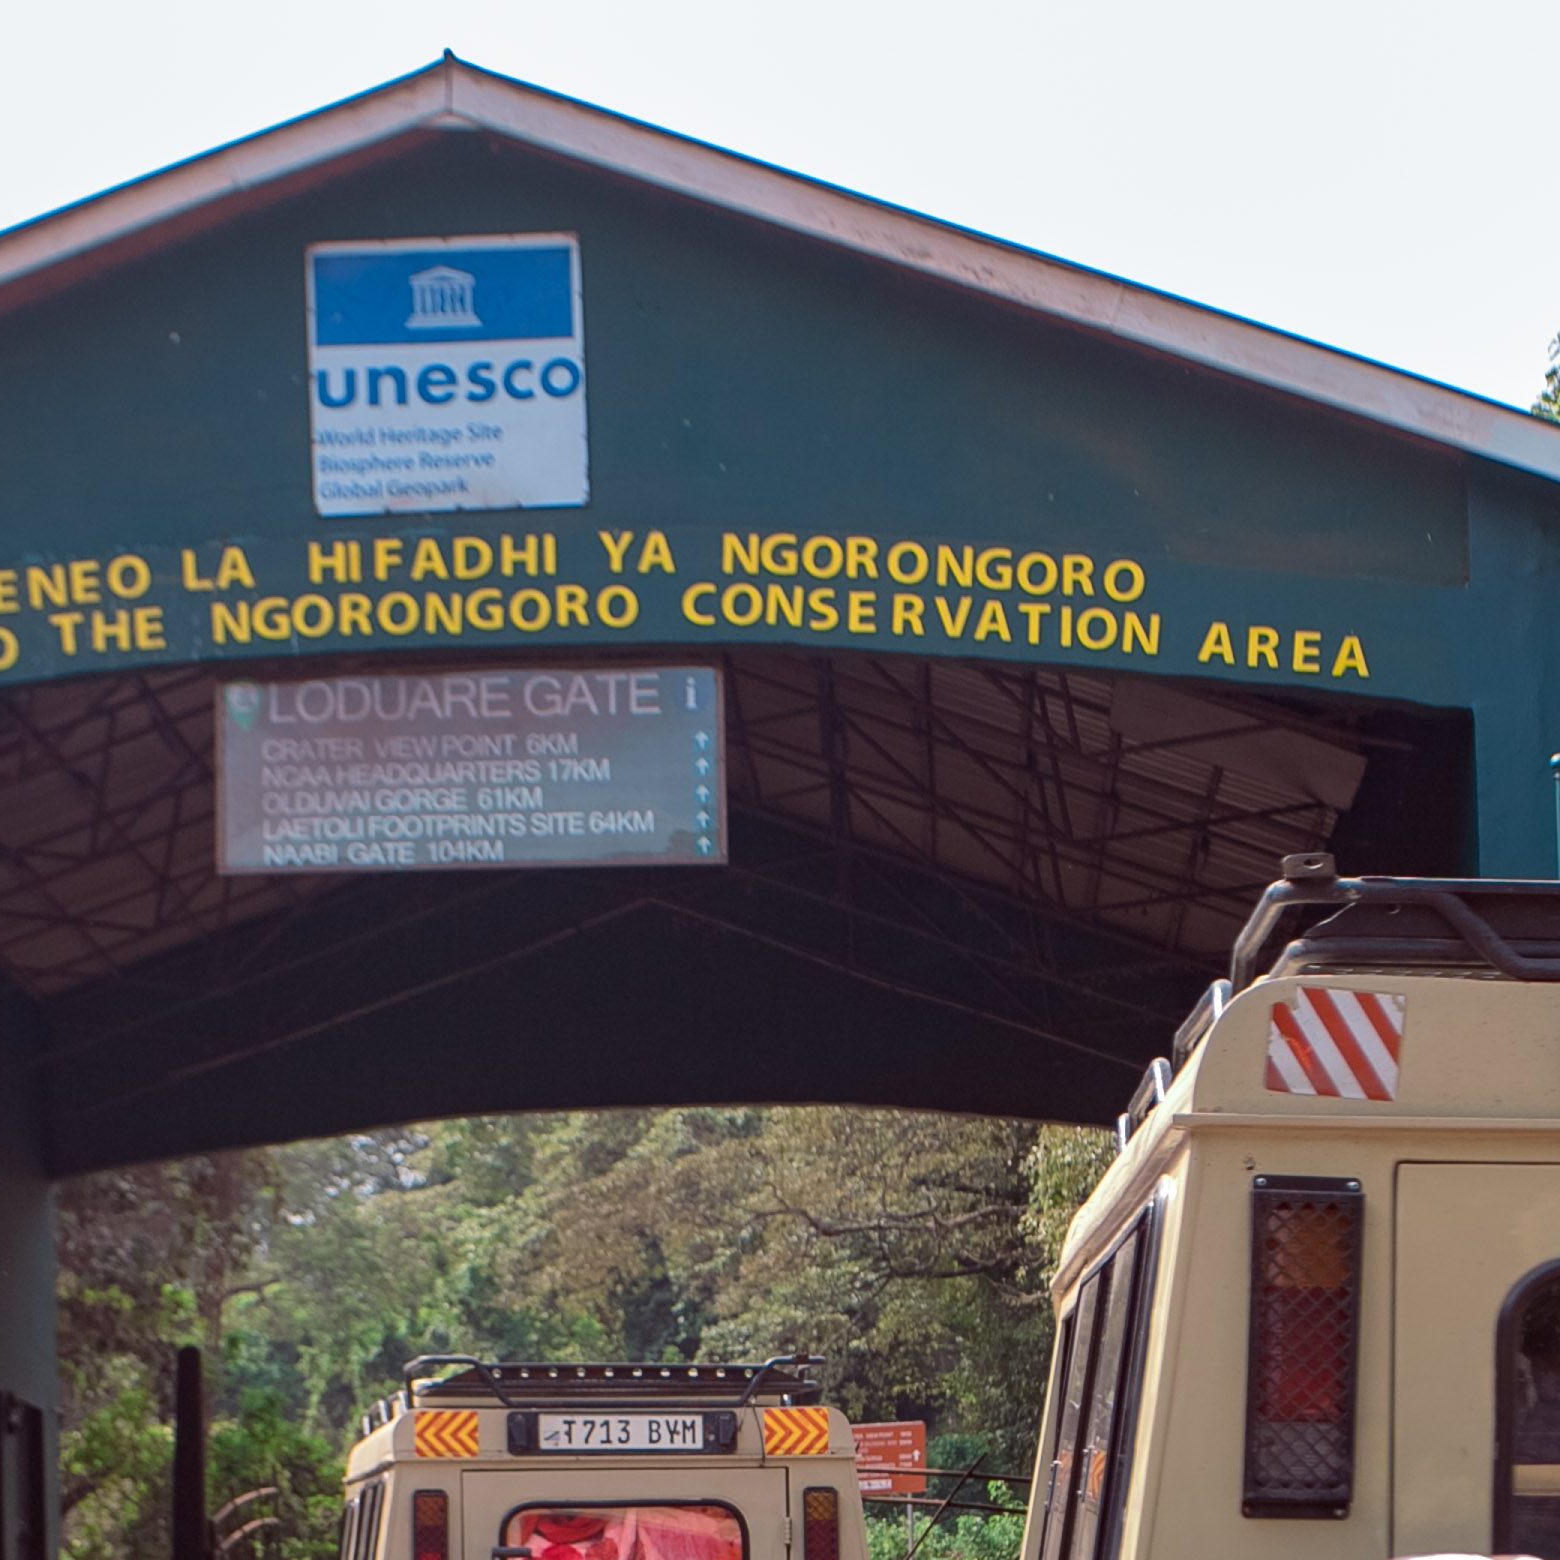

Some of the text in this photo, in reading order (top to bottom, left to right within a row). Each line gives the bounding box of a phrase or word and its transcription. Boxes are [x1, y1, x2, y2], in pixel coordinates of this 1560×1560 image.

[317, 357, 581, 408] unesco
[317, 421, 503, 447] World Heritage Site
[319, 450, 495, 475] Biosphere Reserve
[320, 476, 471, 499] Global Geopark
[182, 548, 254, 591] LA
[309, 534, 556, 584] HIFADHI
[599, 532, 675, 574] YA
[721, 533, 1145, 602] NGORONGORO
[50, 608, 165, 655] THE
[211, 585, 639, 644] NGORONGORO
[682, 583, 1161, 655] CONSERVATION
[1197, 622, 1369, 677] AREA
[268, 673, 662, 725] LODUARE GATE
[261, 732, 578, 762] CRATER VIEW POINT 6KM
[261, 758, 610, 788] NCAA HEADQUARTERS 17KM
[261, 786, 543, 815] OLDUVAI GORGE 61KM
[263, 810, 655, 841] LAETOLI FOOTPRINTS SITE 64KM
[263, 840, 505, 867] NAABI GATE 104KM
[648, 1419, 696, 1444] BYM
